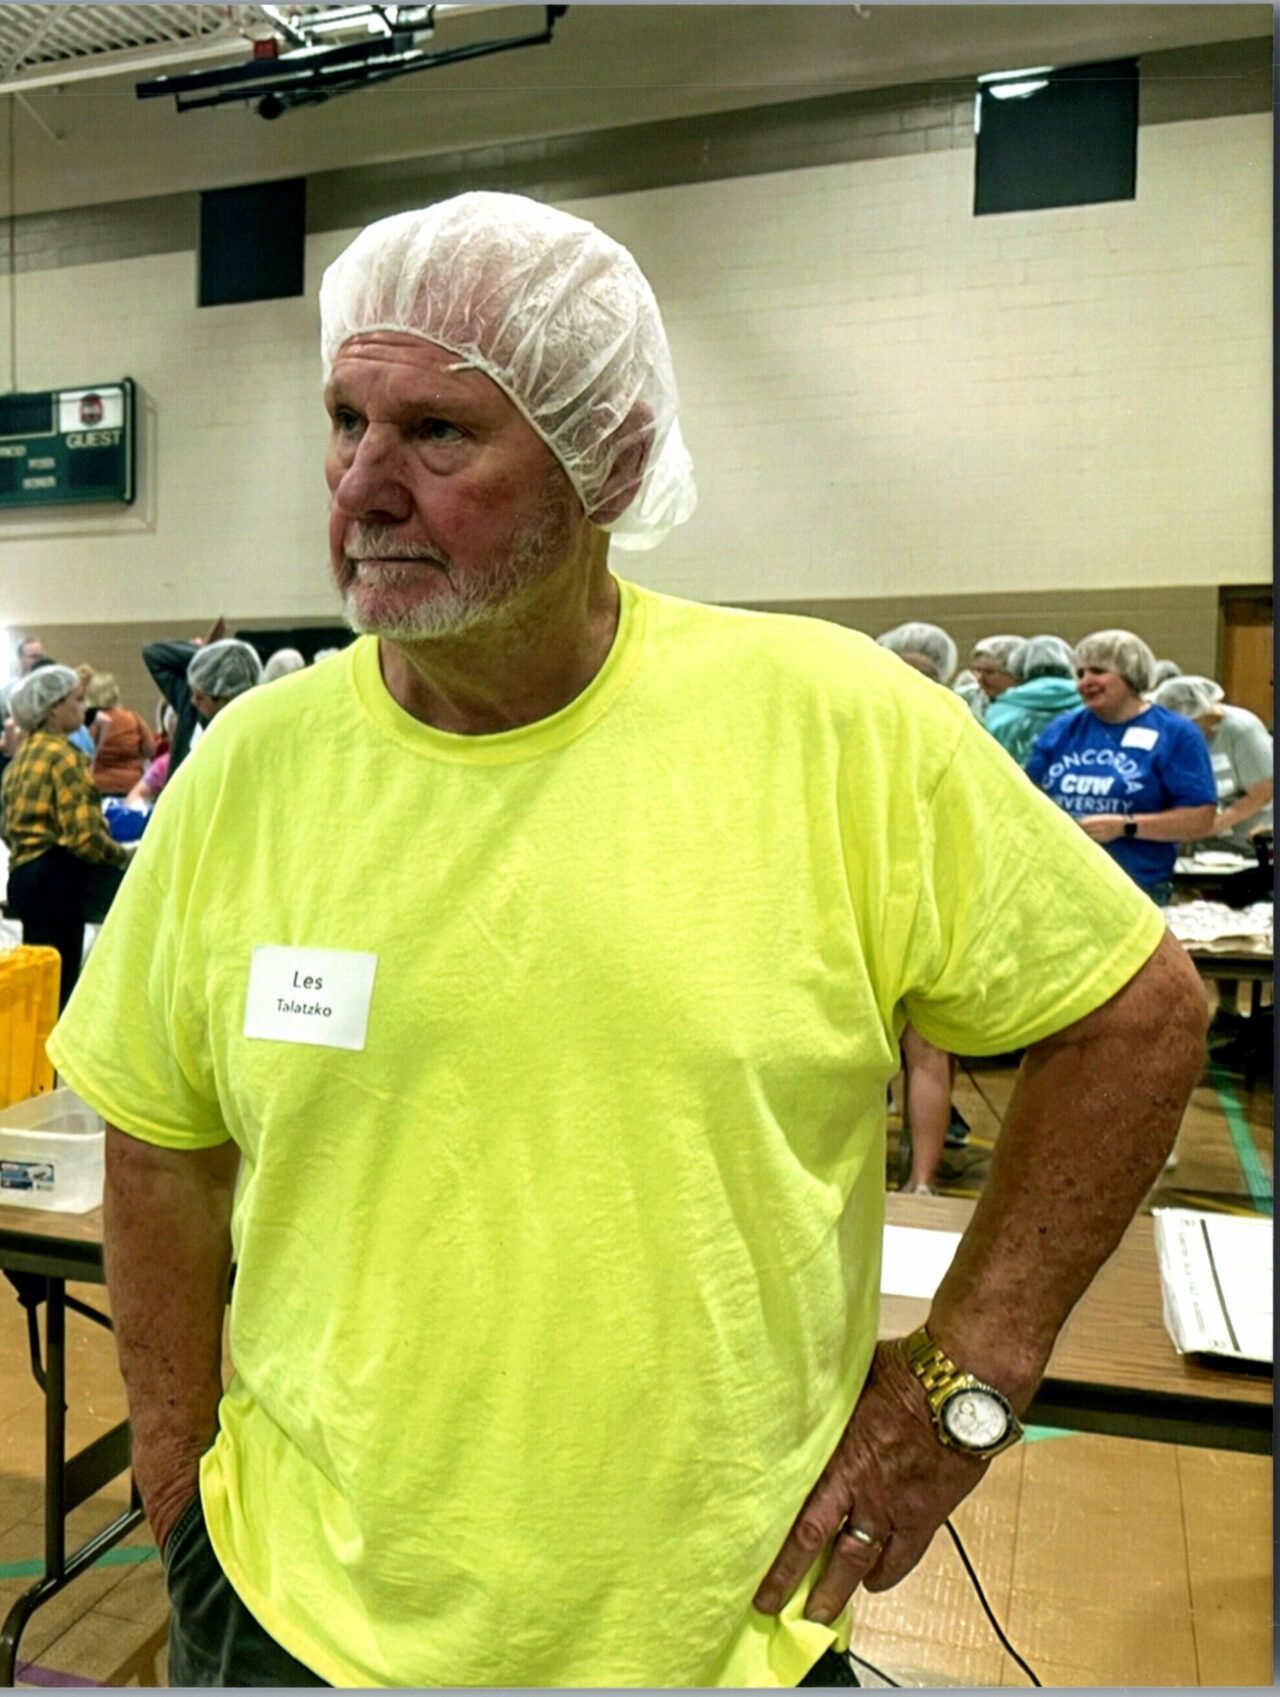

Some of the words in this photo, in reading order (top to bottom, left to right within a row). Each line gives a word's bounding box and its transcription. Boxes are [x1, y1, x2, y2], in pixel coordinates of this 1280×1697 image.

[66, 430, 122, 449] GUEST
[1041, 749, 1144, 795] CONCORDIA
[1060, 774, 1115, 796] CUW
[293, 970, 323, 990] Les
[277, 998, 332, 1017] Talatzko
